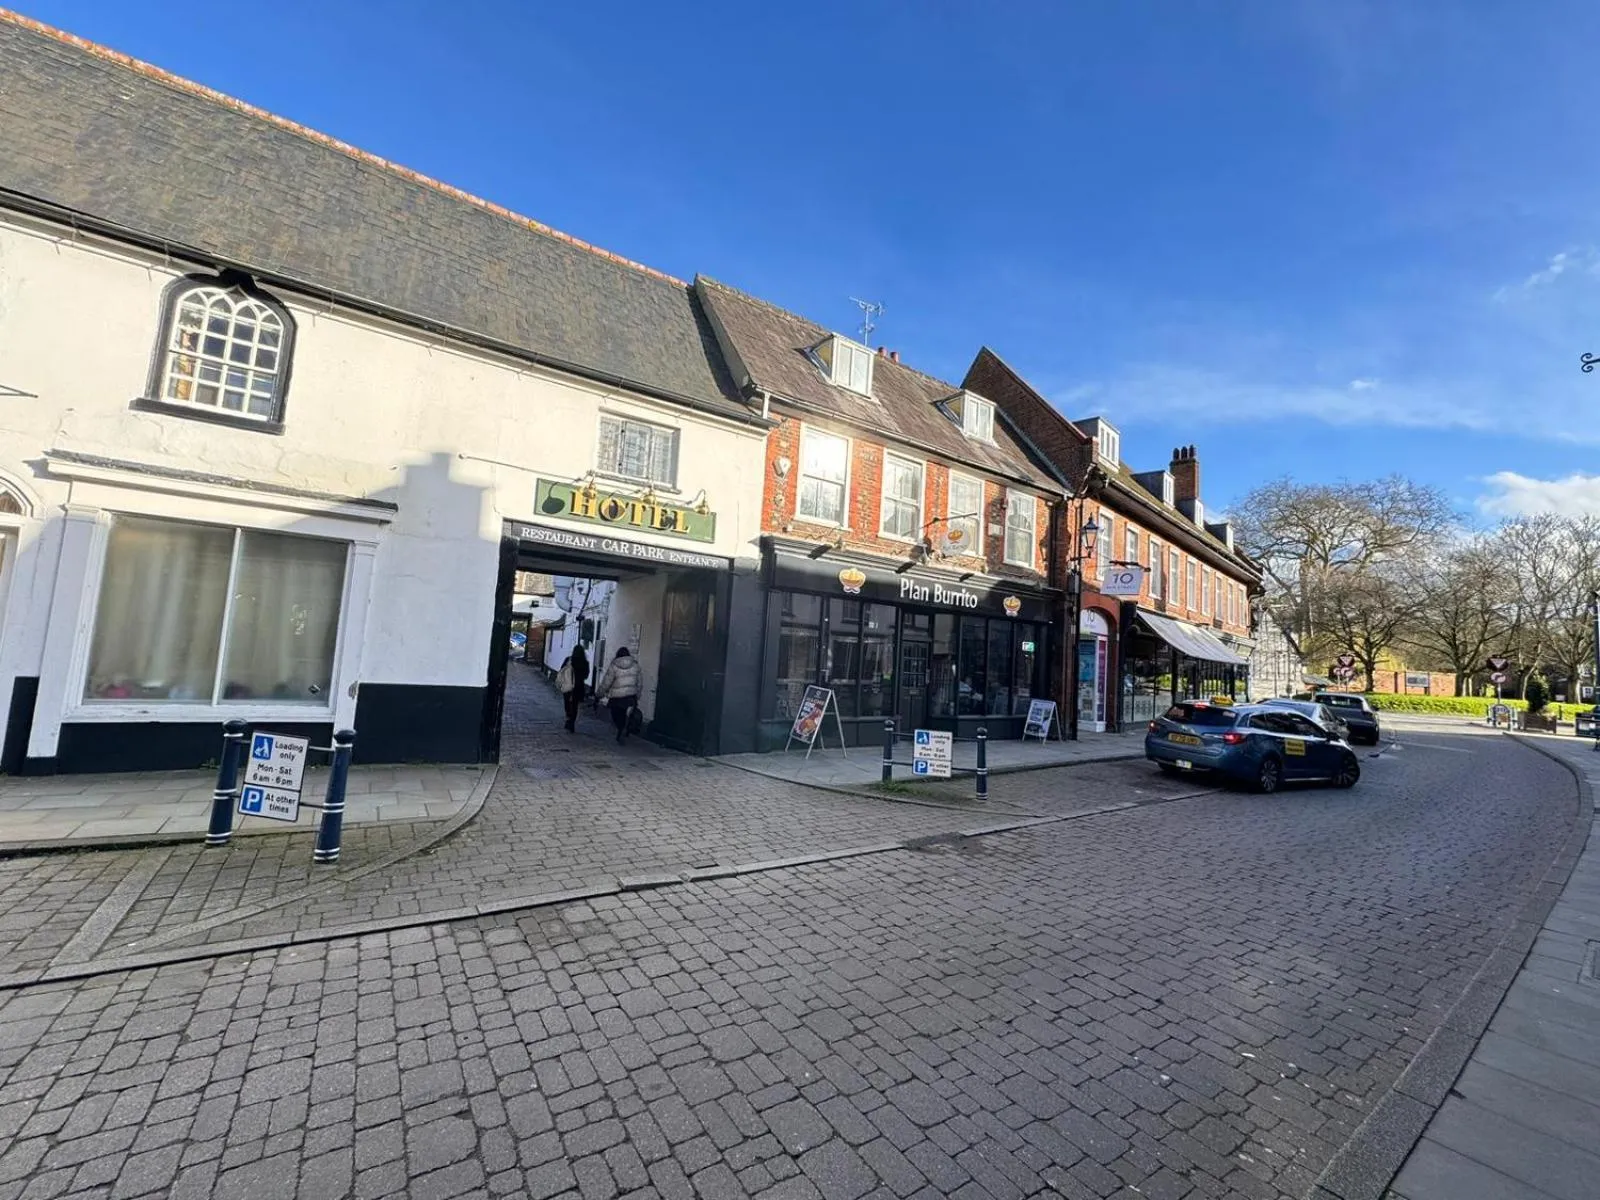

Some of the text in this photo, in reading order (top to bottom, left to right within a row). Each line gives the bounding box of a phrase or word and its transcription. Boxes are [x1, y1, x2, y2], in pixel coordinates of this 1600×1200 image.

[570, 487, 691, 534] HOTEL
[521, 527, 718, 567] RESTAURANT CAR PARK ENTRANCE
[1112, 573, 1134, 584] 10
[899, 577, 979, 609] Plan Burrito
[275, 741, 303, 753] Loading
[280, 753, 296, 761] only
[257, 763, 273, 772] Mon
[279, 766, 292, 775] Sat
[265, 793, 296, 804] At other
[269, 804, 289, 813] times
